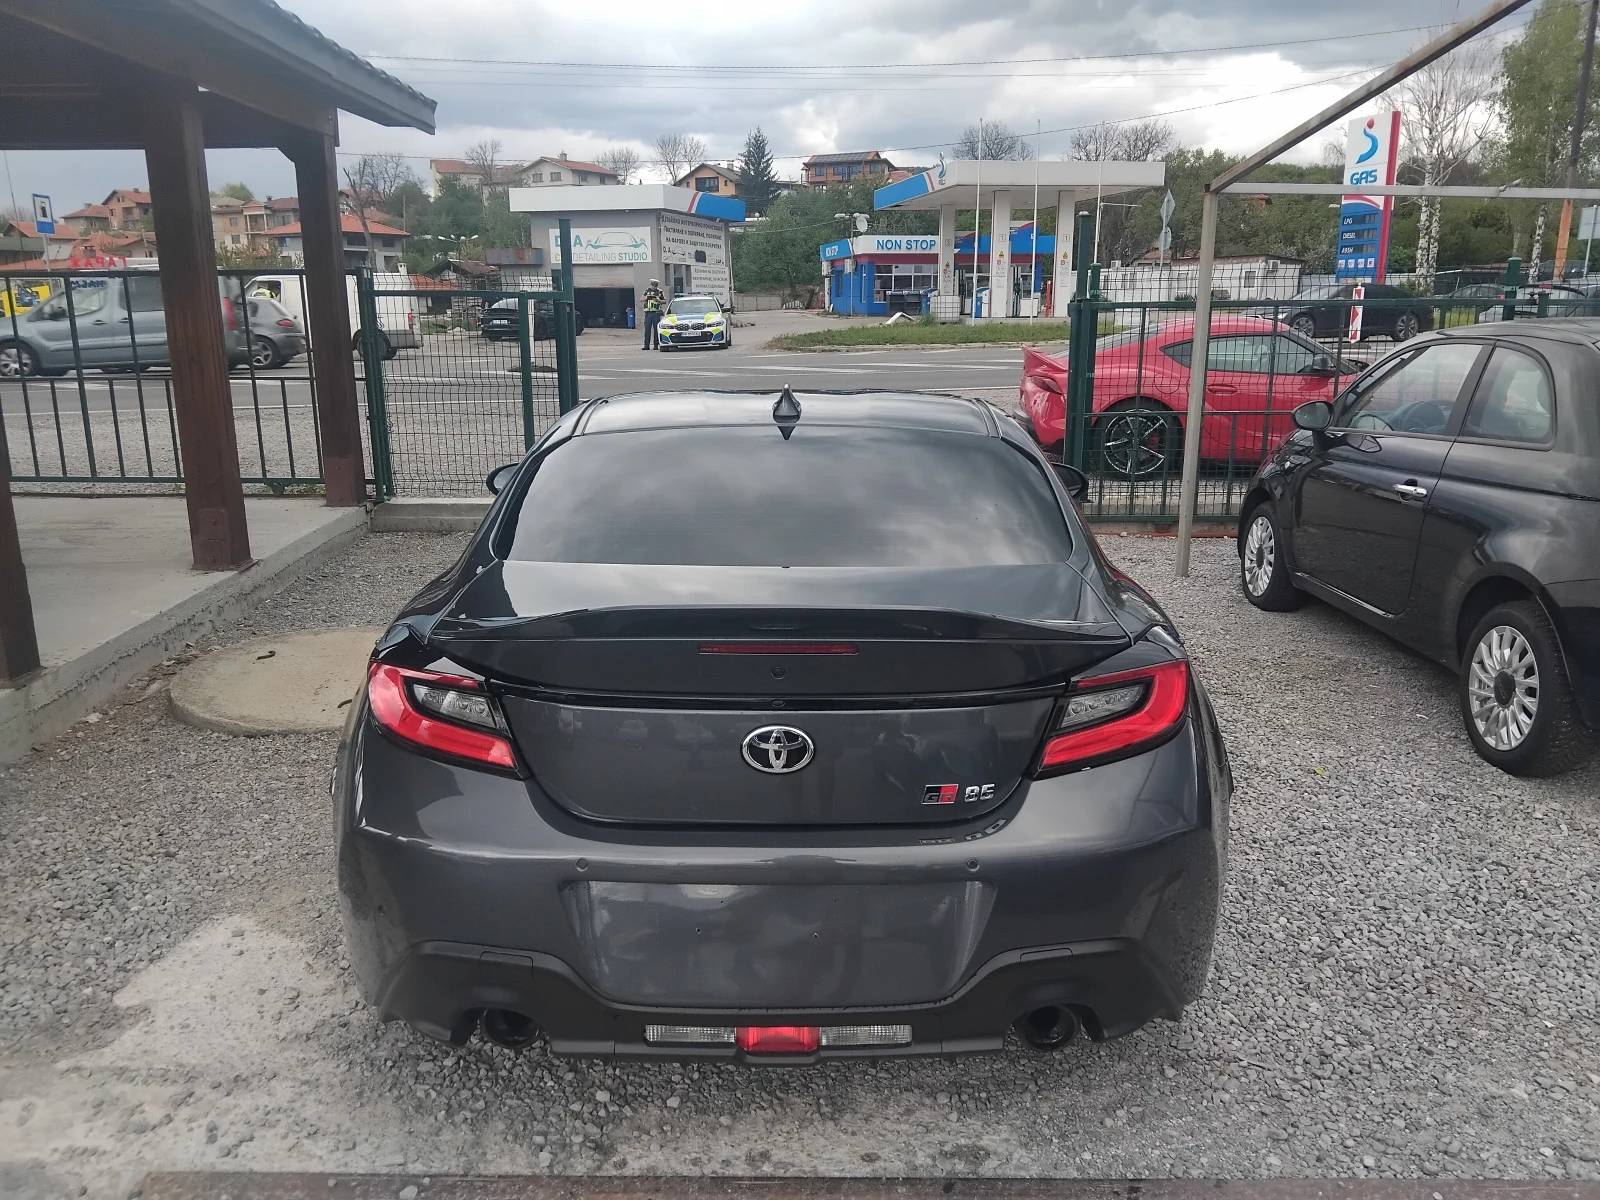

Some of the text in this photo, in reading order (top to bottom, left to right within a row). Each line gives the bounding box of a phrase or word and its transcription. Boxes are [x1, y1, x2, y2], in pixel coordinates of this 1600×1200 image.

[1350, 169, 1378, 185] GAS
[876, 239, 936, 250] NON STOP
[573, 252, 647, 262] DETAILING STUDIO
[922, 791, 956, 804] GR
